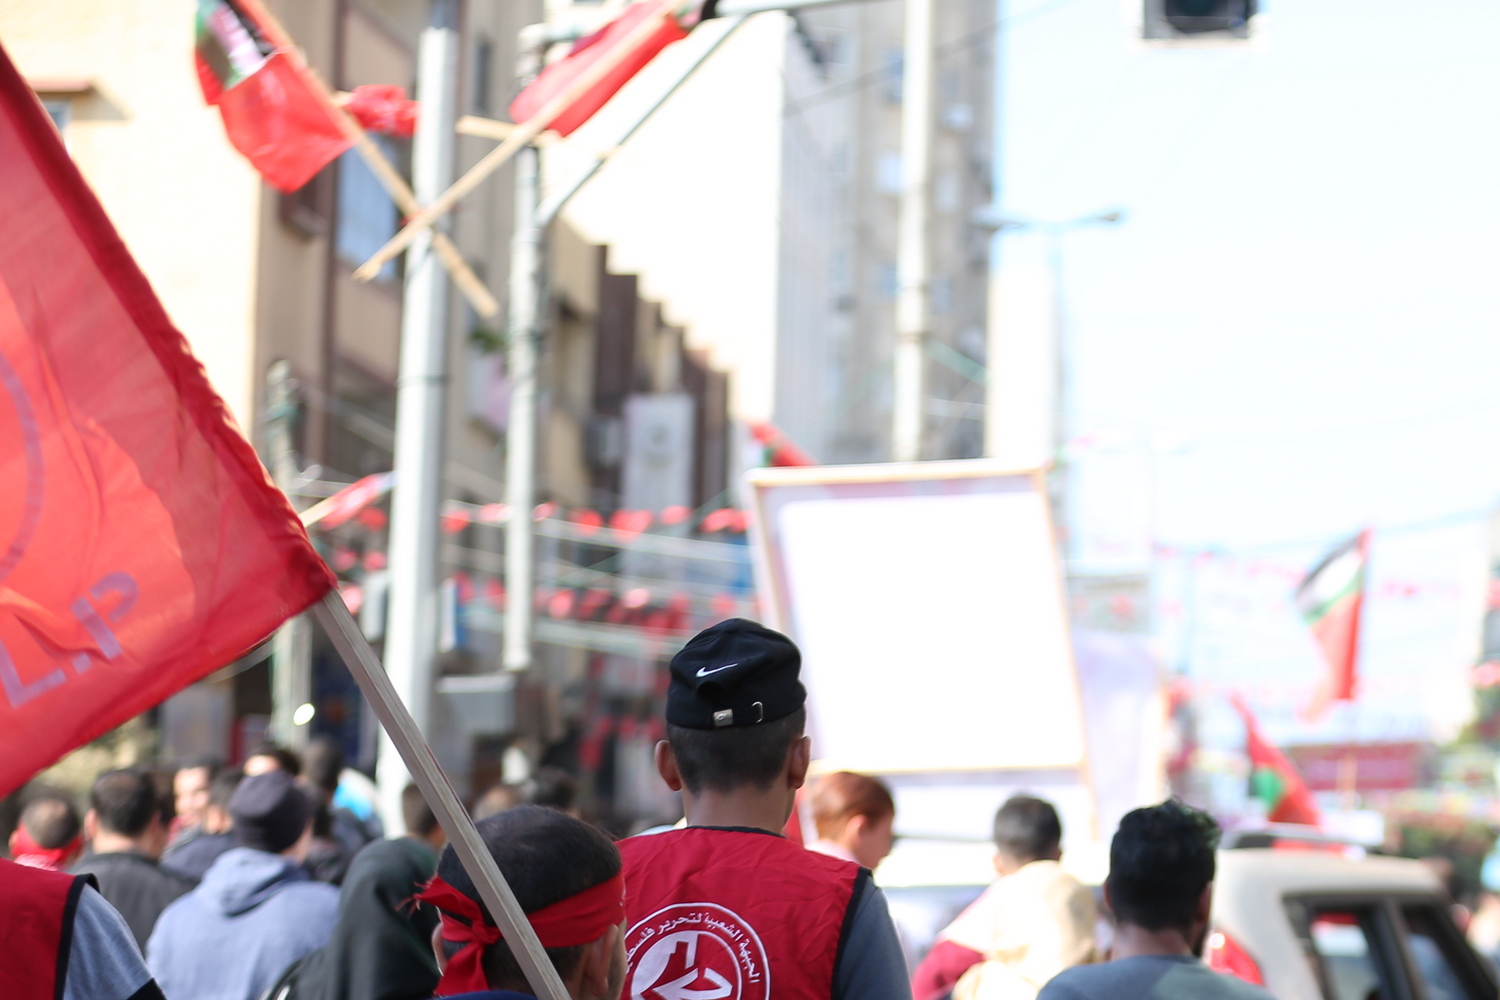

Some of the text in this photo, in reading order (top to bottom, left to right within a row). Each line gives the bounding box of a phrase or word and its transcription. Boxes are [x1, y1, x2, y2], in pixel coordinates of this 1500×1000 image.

[657, 912, 703, 936] لتحرير
[703, 912, 745, 942] الشعبية
[739, 938, 761, 984] الجبهة
